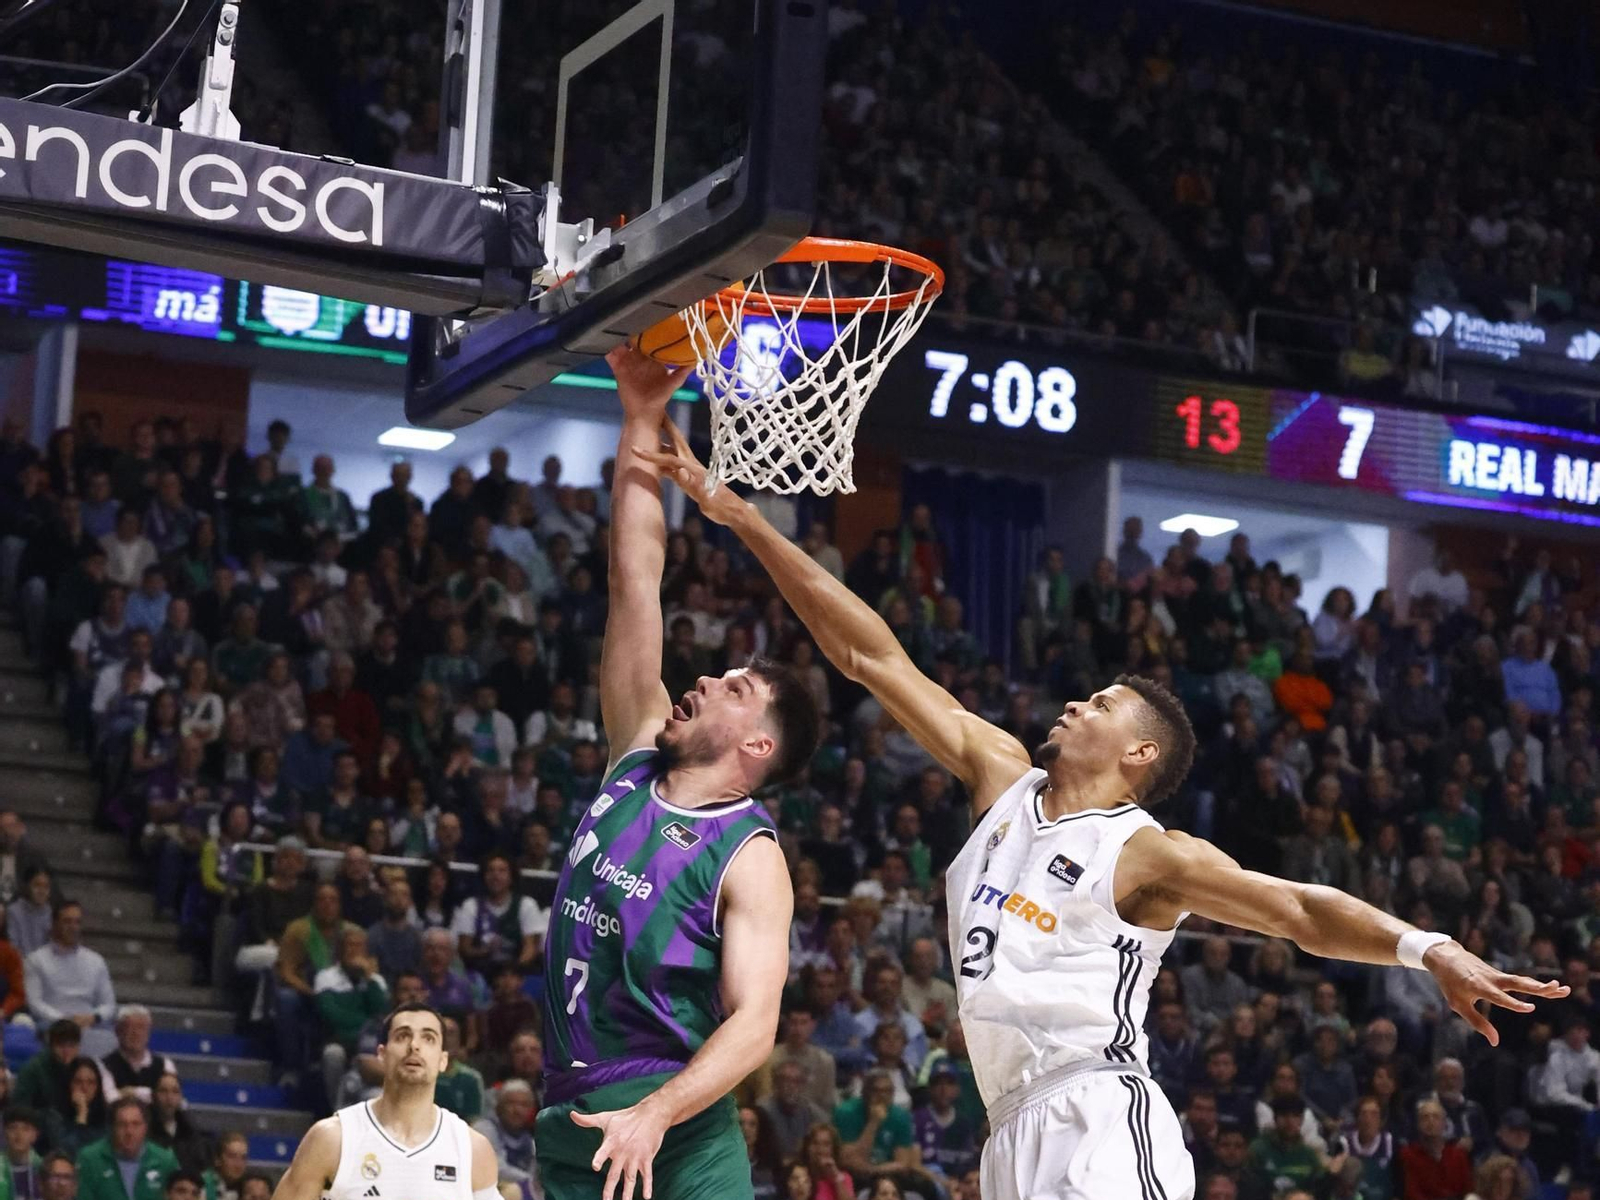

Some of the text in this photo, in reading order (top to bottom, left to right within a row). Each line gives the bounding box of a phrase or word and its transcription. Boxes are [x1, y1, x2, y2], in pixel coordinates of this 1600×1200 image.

[0, 122, 384, 246] ndesa
[925, 350, 1077, 433] 7:08
[1176, 396, 1241, 454] 13
[1338, 406, 1375, 480] 7
[1449, 440, 1545, 497] REAL
[591, 853, 653, 901] Unicaja
[565, 957, 589, 1015] 7
